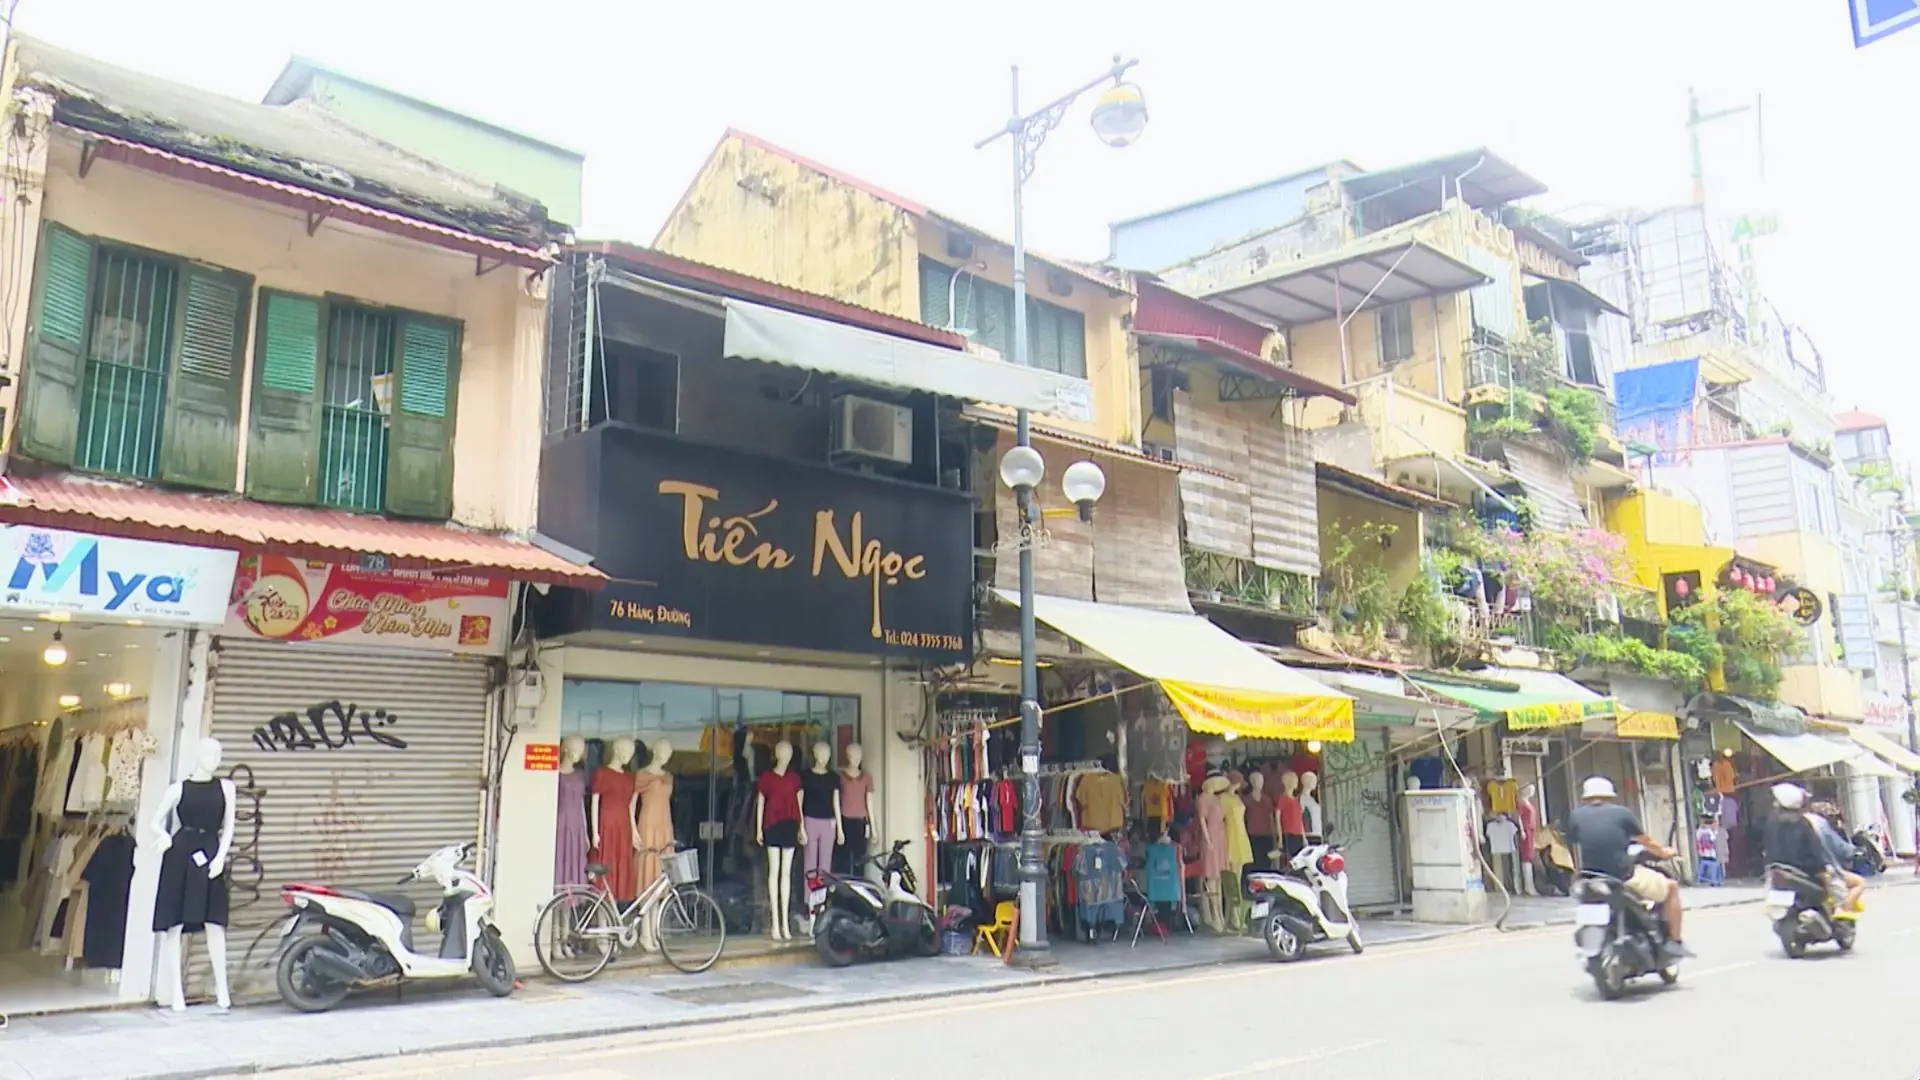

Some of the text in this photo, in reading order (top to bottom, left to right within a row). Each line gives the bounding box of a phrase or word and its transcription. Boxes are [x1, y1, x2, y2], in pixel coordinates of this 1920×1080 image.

[367, 555, 385, 569] 78
[658, 479, 926, 638] Tiến Ngọc
[610, 600, 625, 618] 76
[900, 631, 919, 647] 024
